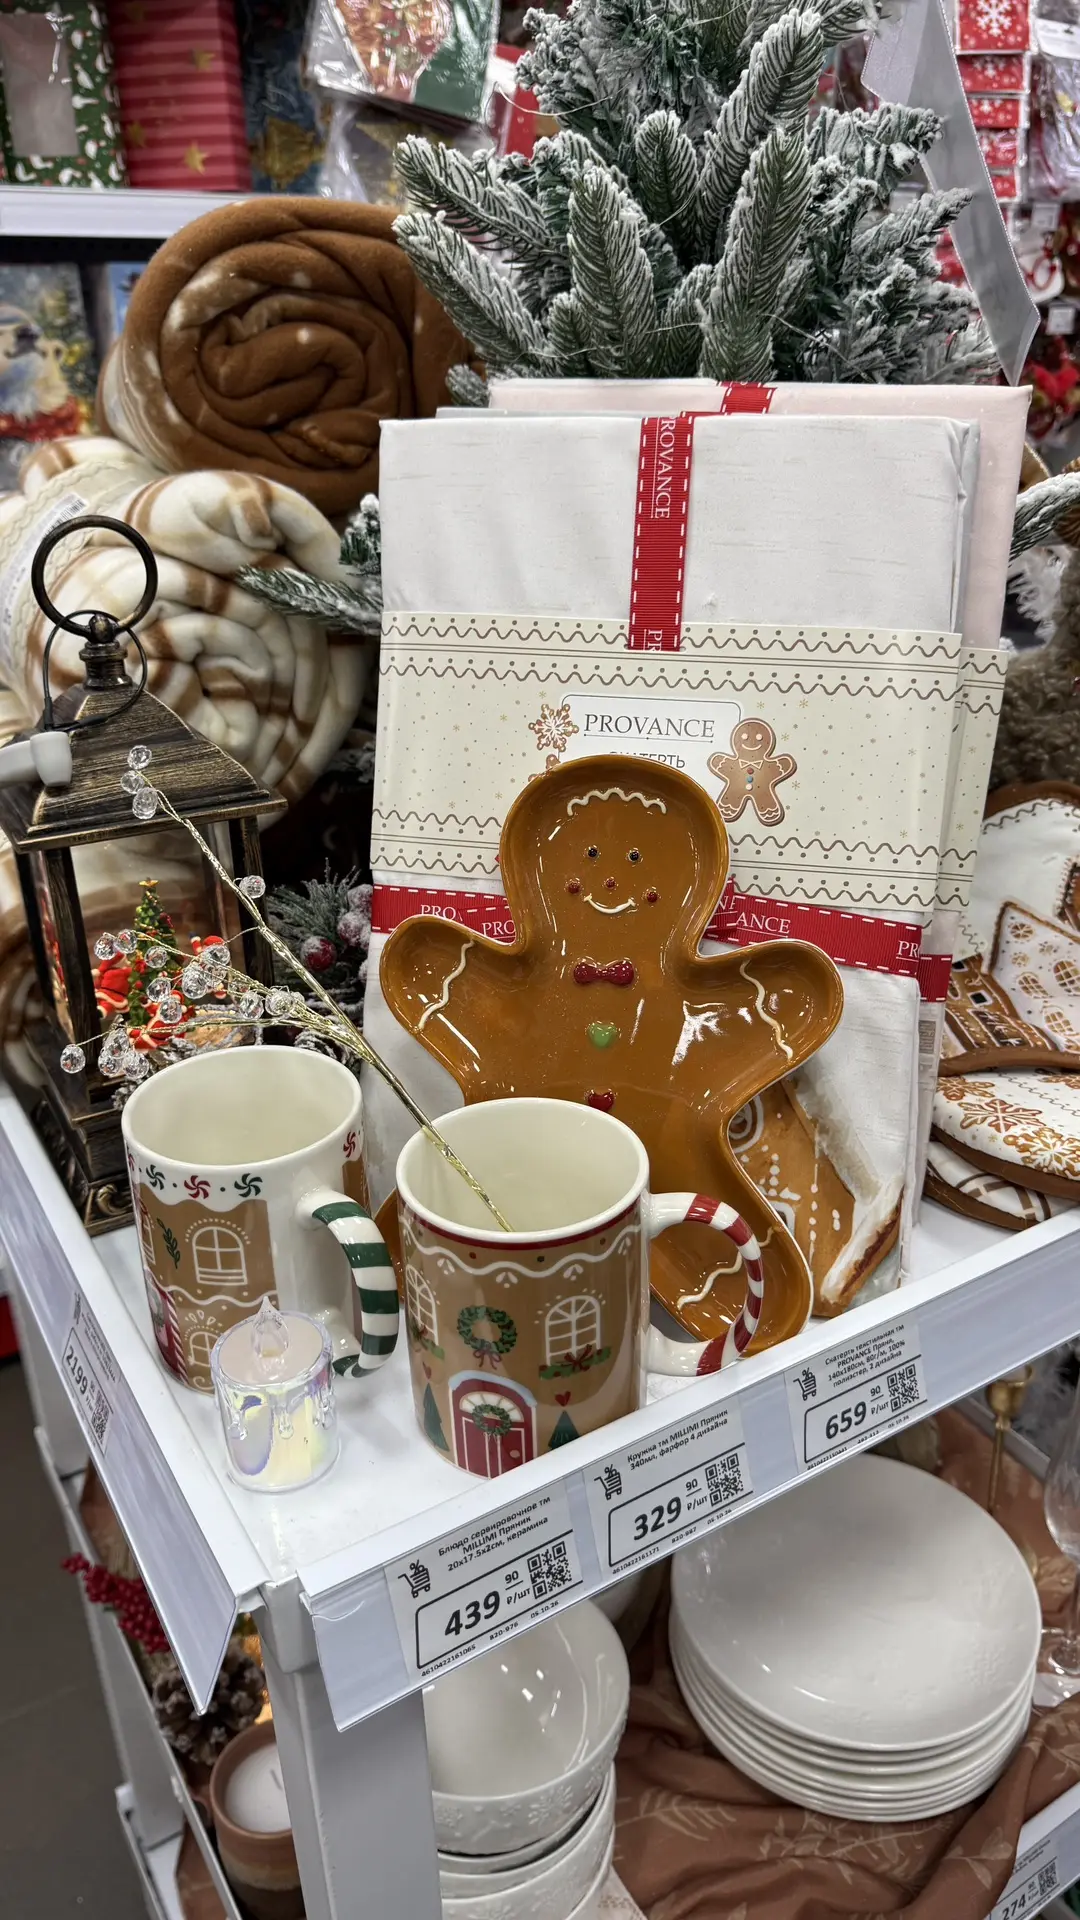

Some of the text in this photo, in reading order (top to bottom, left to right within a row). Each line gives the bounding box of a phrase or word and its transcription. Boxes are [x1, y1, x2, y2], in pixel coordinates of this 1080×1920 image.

[653, 416, 677, 519] ROVANCE
[584, 714, 715, 738] PROVANCE
[421, 904, 463, 921] PRO
[736, 912, 791, 934] ANCE
[896, 940, 920, 958] PR
[825, 1348, 855, 1366] Скатерть
[855, 1328, 895, 1351] текстильная
[837, 1347, 871, 1368] PROVANCE
[889, 1339, 906, 1352] 100%
[66, 1345, 88, 1395] 2199
[875, 1350, 902, 1369] дизайна
[870, 1385, 881, 1397] 90
[825, 1401, 867, 1439] 659
[627, 1444, 657, 1463] Кружка
[669, 1422, 699, 1442] MILLIMI
[700, 1409, 728, 1428] Пряник
[630, 1454, 658, 1470] 340мл,
[659, 1437, 689, 1458] фарфор
[696, 1418, 728, 1440] дизайна
[685, 1478, 698, 1491] 90
[438, 1496, 551, 1556] Блюдо сервировочное тм
[507, 1516, 549, 1543] керамика
[633, 1496, 682, 1541] 329
[463, 1516, 532, 1554] MILLIMI Пряник
[505, 1570, 519, 1584] 90
[444, 1590, 501, 1636] 439
[421, 1600, 559, 1677] 4610422161065 820-976 05.10.26
[1002, 1893, 1027, 1920] 274
